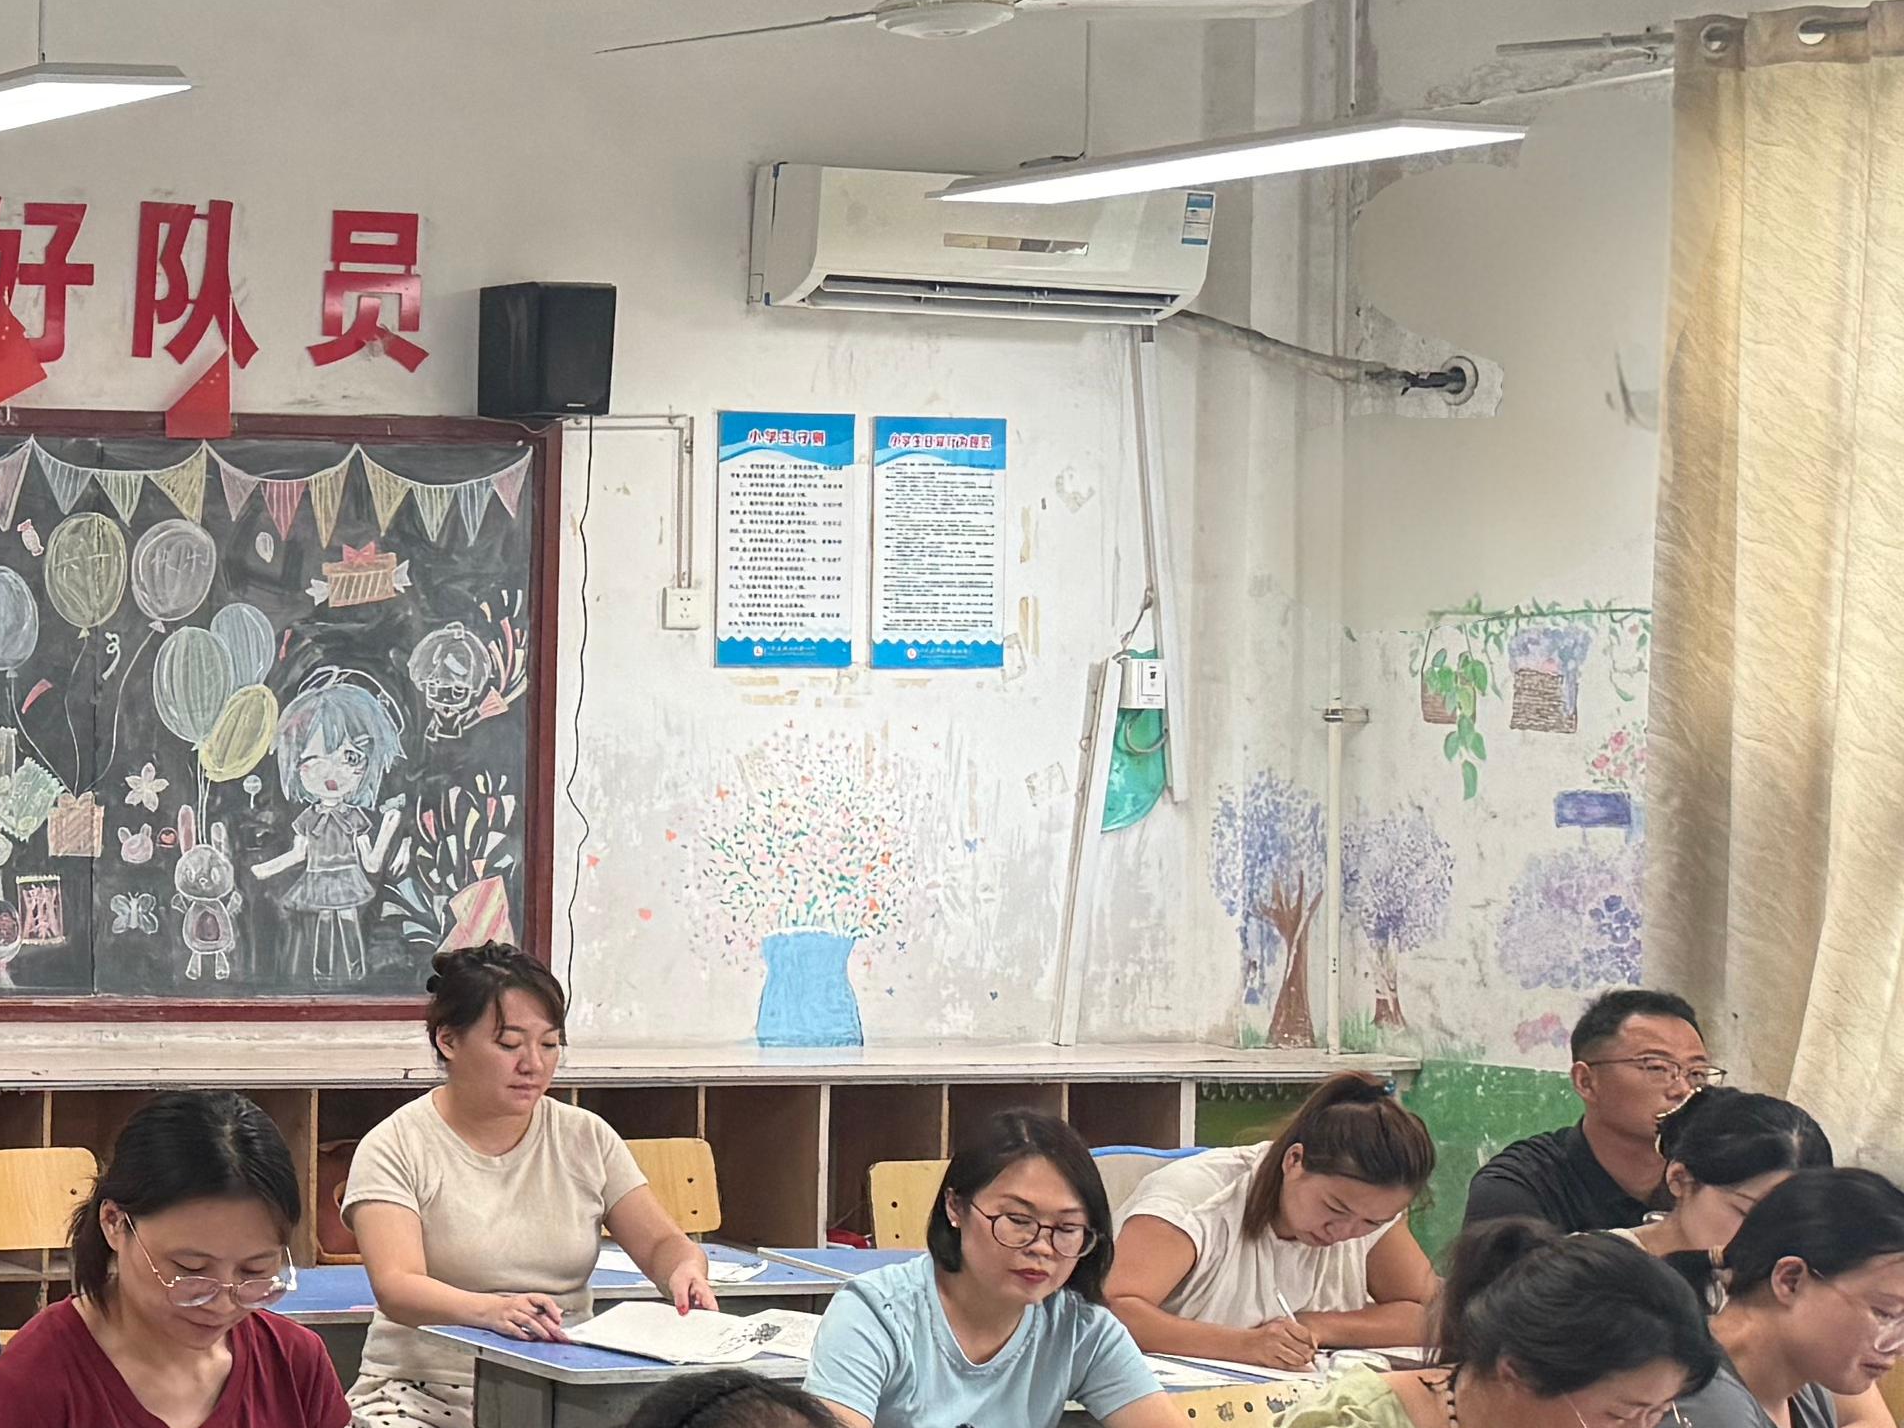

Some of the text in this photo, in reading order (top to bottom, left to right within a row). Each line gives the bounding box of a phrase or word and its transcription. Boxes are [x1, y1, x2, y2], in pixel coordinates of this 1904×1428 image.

[748, 428, 826, 446] 小学生守则
